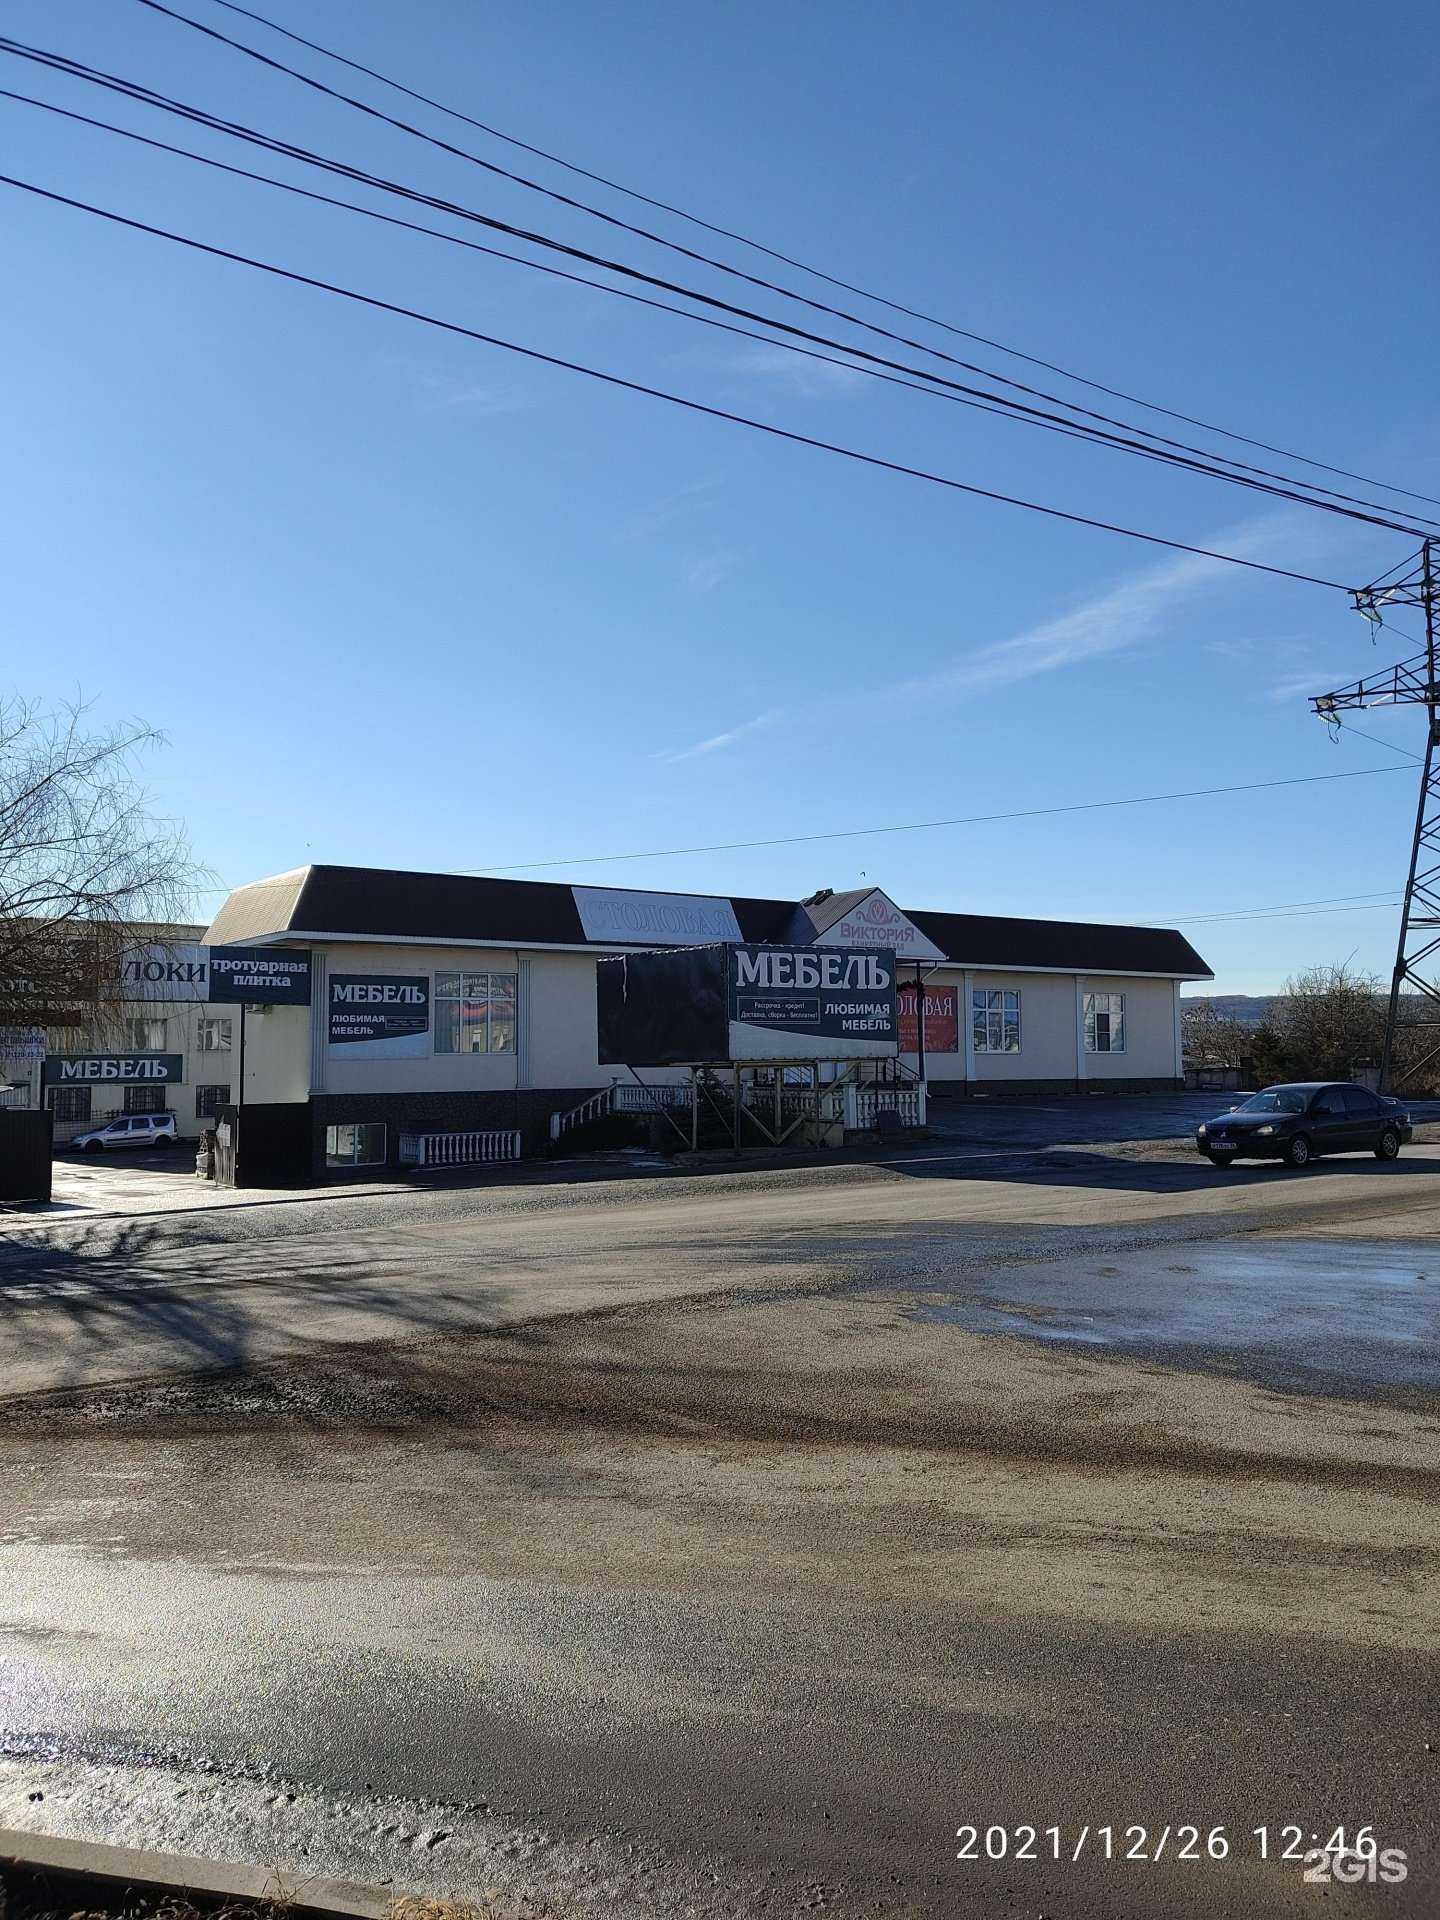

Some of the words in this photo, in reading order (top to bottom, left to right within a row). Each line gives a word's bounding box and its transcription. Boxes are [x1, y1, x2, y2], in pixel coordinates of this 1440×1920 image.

[584, 901, 737, 936] СТОЛОВАЯ
[211, 959, 308, 974] тротуарная
[735, 951, 890, 990] МЕБЕЛЬ
[233, 975, 291, 987] плитка
[332, 984, 426, 1004] МЕБЕЛЬ
[825, 1003, 890, 1015] ЛЮБИМАЯ
[332, 1014, 385, 1023] ЛЮБИМАЯ
[332, 1026, 374, 1035] МЕБЕЛЬ
[842, 1020, 891, 1031] МЕБЕЛЬ
[60, 1060, 168, 1080] МЕБЕЛЬ
